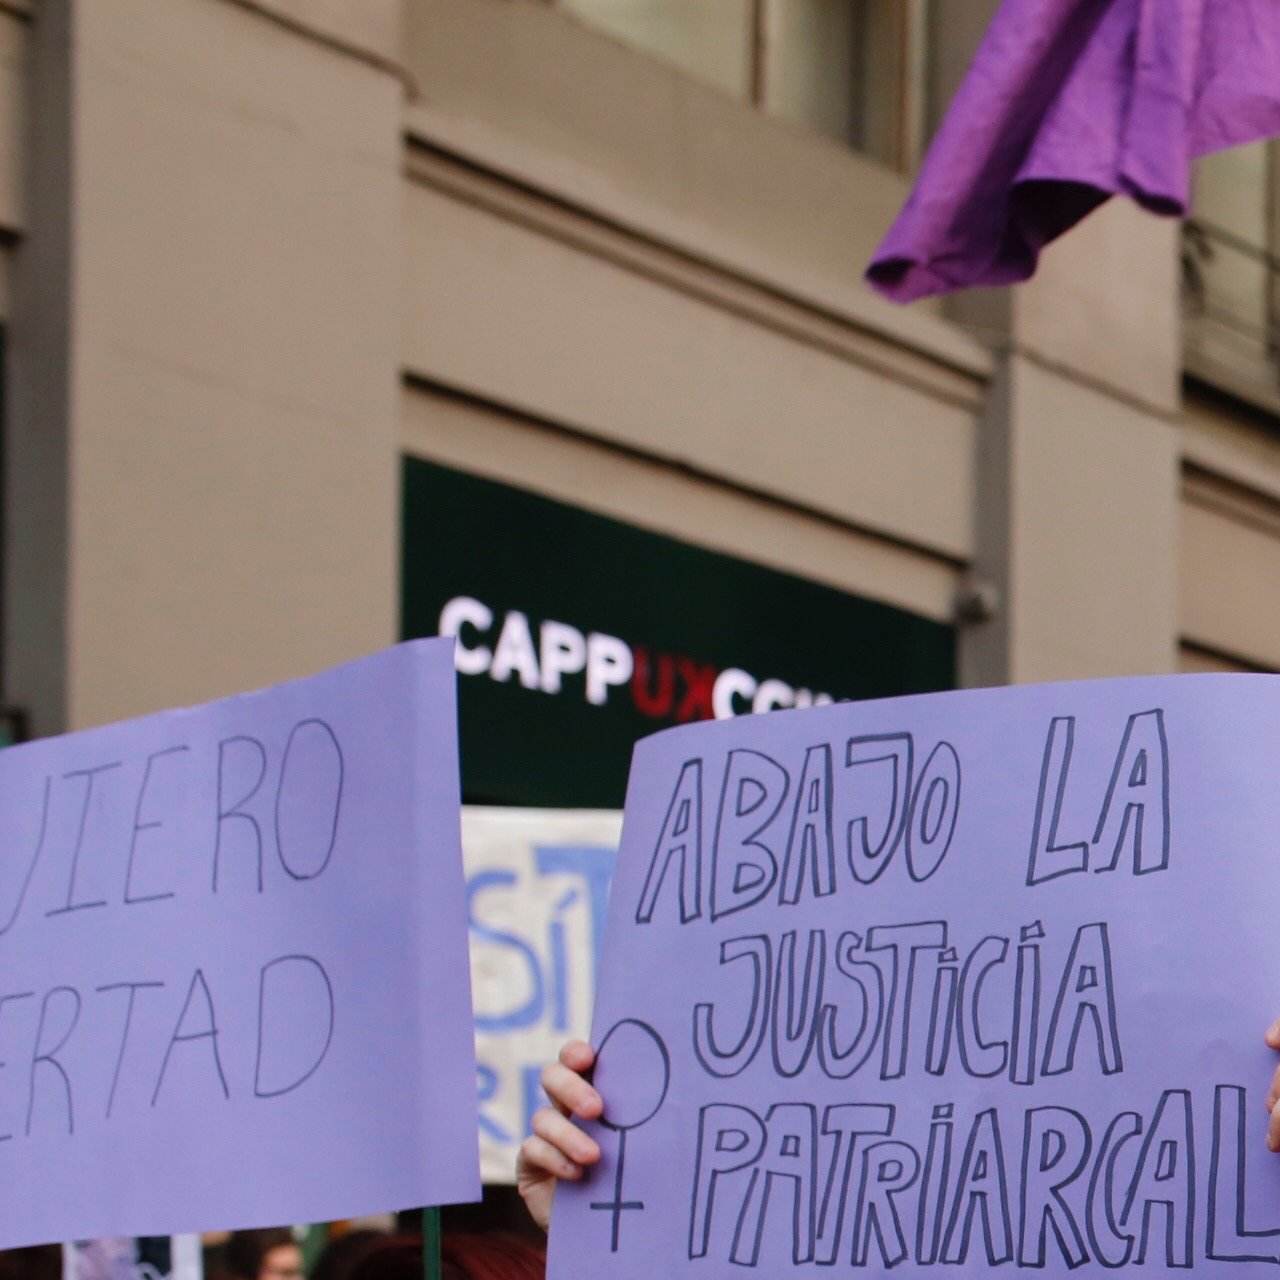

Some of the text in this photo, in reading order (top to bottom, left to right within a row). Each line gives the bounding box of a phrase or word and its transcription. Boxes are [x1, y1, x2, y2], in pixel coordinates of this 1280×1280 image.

[635, 708, 1170, 926] ABAJO LA
[0, 953, 335, 1138] RTAD
